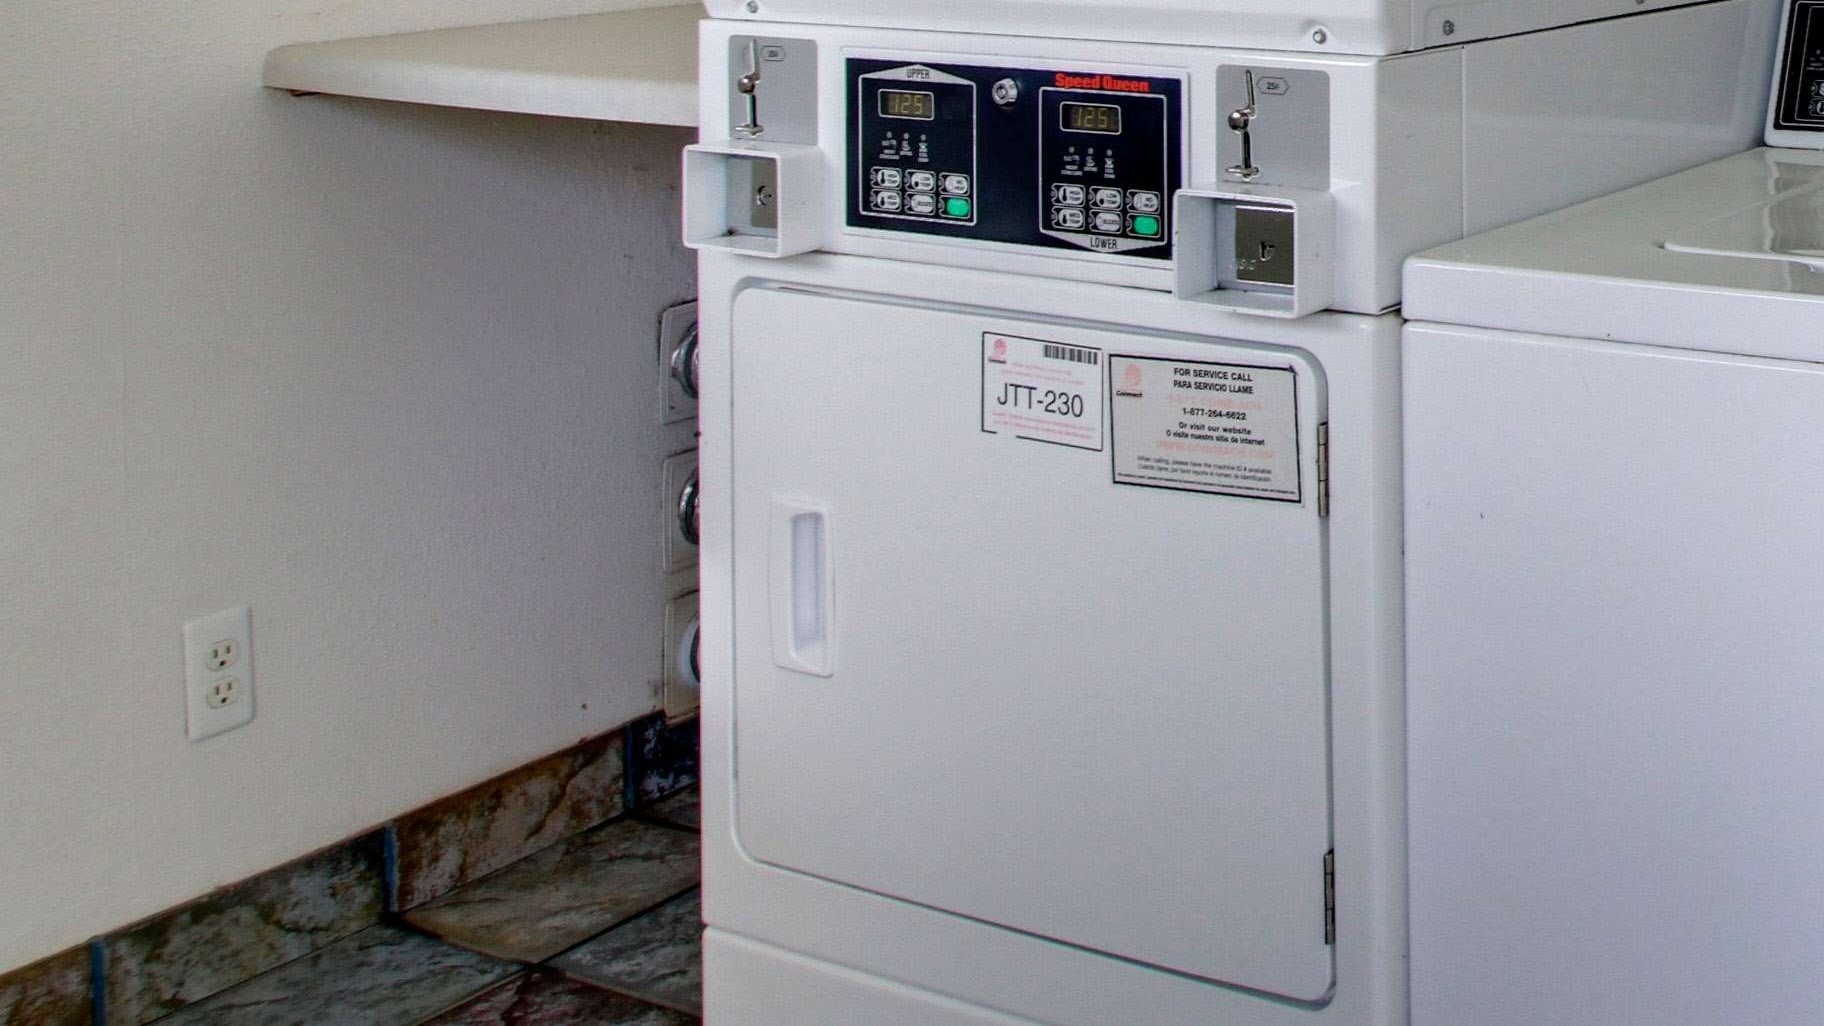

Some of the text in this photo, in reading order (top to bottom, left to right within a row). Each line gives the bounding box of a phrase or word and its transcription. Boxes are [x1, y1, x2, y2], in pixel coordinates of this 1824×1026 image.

[907, 68, 930, 79] UPPER
[1056, 74, 1149, 92] Speed Queen
[892, 94, 922, 114] 125
[1074, 107, 1108, 127] 125
[1090, 238, 1117, 249] LOWER
[1174, 368, 1253, 381] FOR SERVICE CALL
[1174, 380, 1253, 394] PARA SERVICIO LLAME
[997, 383, 1083, 417] JTT-230
[1190, 422, 1205, 431] visit
[1223, 426, 1251, 435] website
